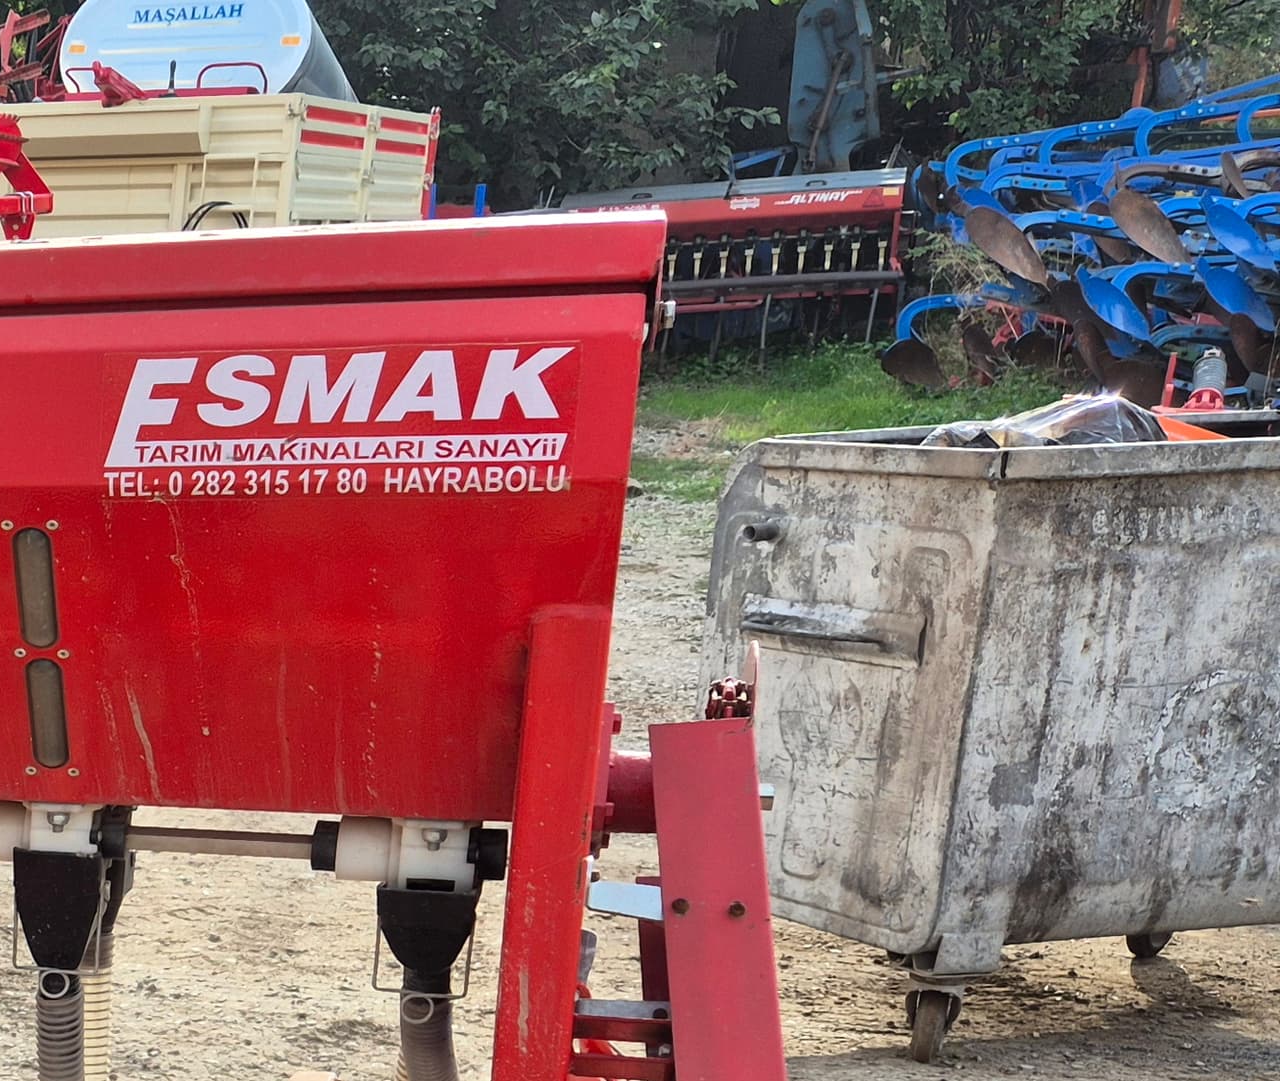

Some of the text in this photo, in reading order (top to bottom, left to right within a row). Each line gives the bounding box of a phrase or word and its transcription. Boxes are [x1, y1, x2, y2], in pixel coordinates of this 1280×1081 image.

[133, 3, 244, 26] MAŞALLAH
[786, 190, 854, 205] ALTINAY
[104, 347, 575, 467] ESMAK
[135, 444, 221, 463] TARIM
[104, 465, 567, 496] TEL: 0 282 315 17 80 HAYRABOLU
